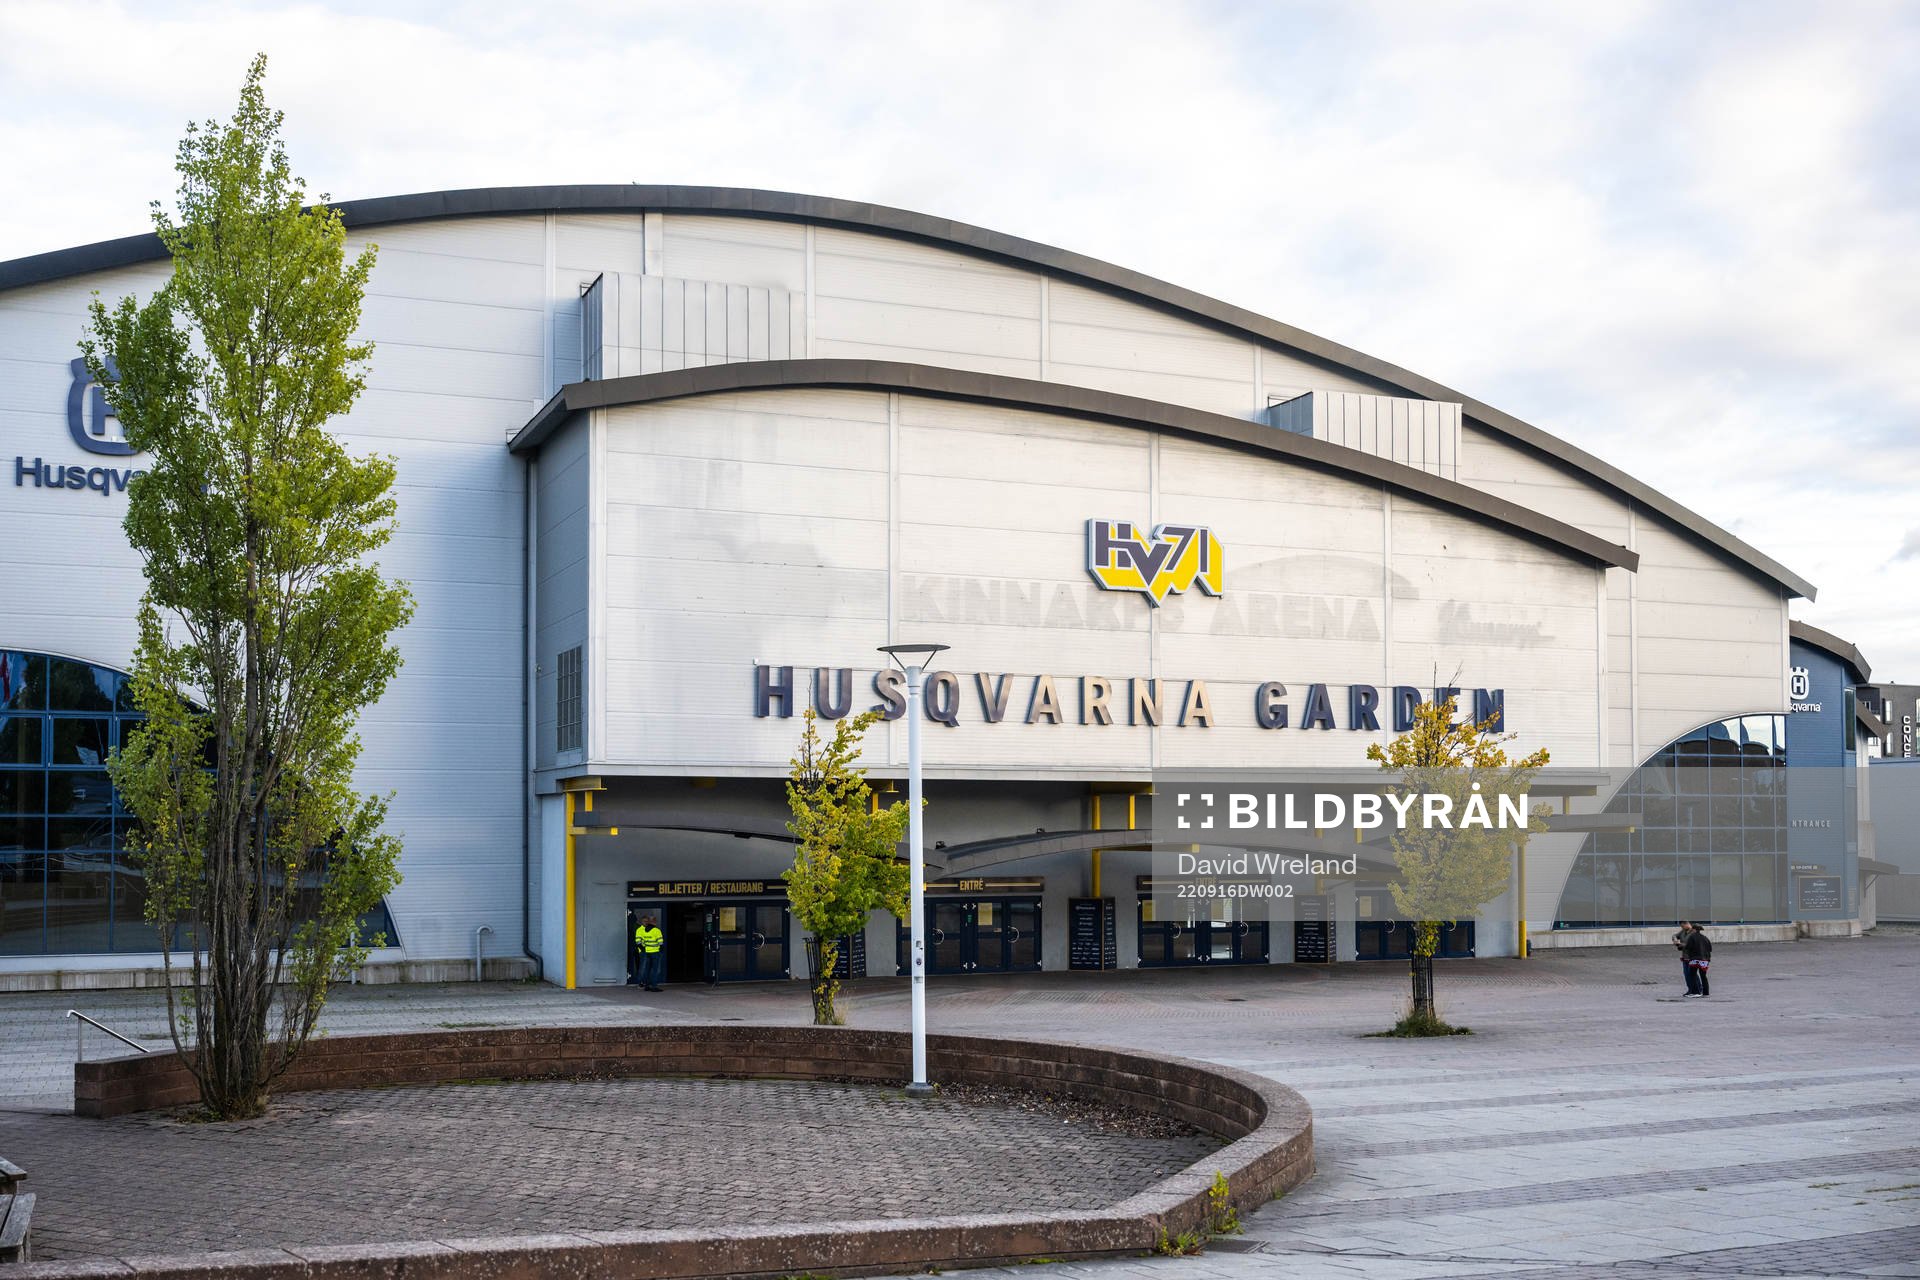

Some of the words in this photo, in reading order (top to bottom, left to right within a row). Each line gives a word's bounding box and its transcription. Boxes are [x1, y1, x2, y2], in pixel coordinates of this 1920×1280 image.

[15, 455, 153, 496] Husqv
[1093, 519, 1212, 590] HV71
[1208, 591, 1381, 642] ARENA
[755, 665, 1214, 728] HUSQVARNA
[1255, 680, 1505, 734] GARDEN
[658, 882, 703, 895] BILJETTER
[710, 881, 764, 894] RESTAURANG
[959, 877, 984, 891] ENTRÉ
